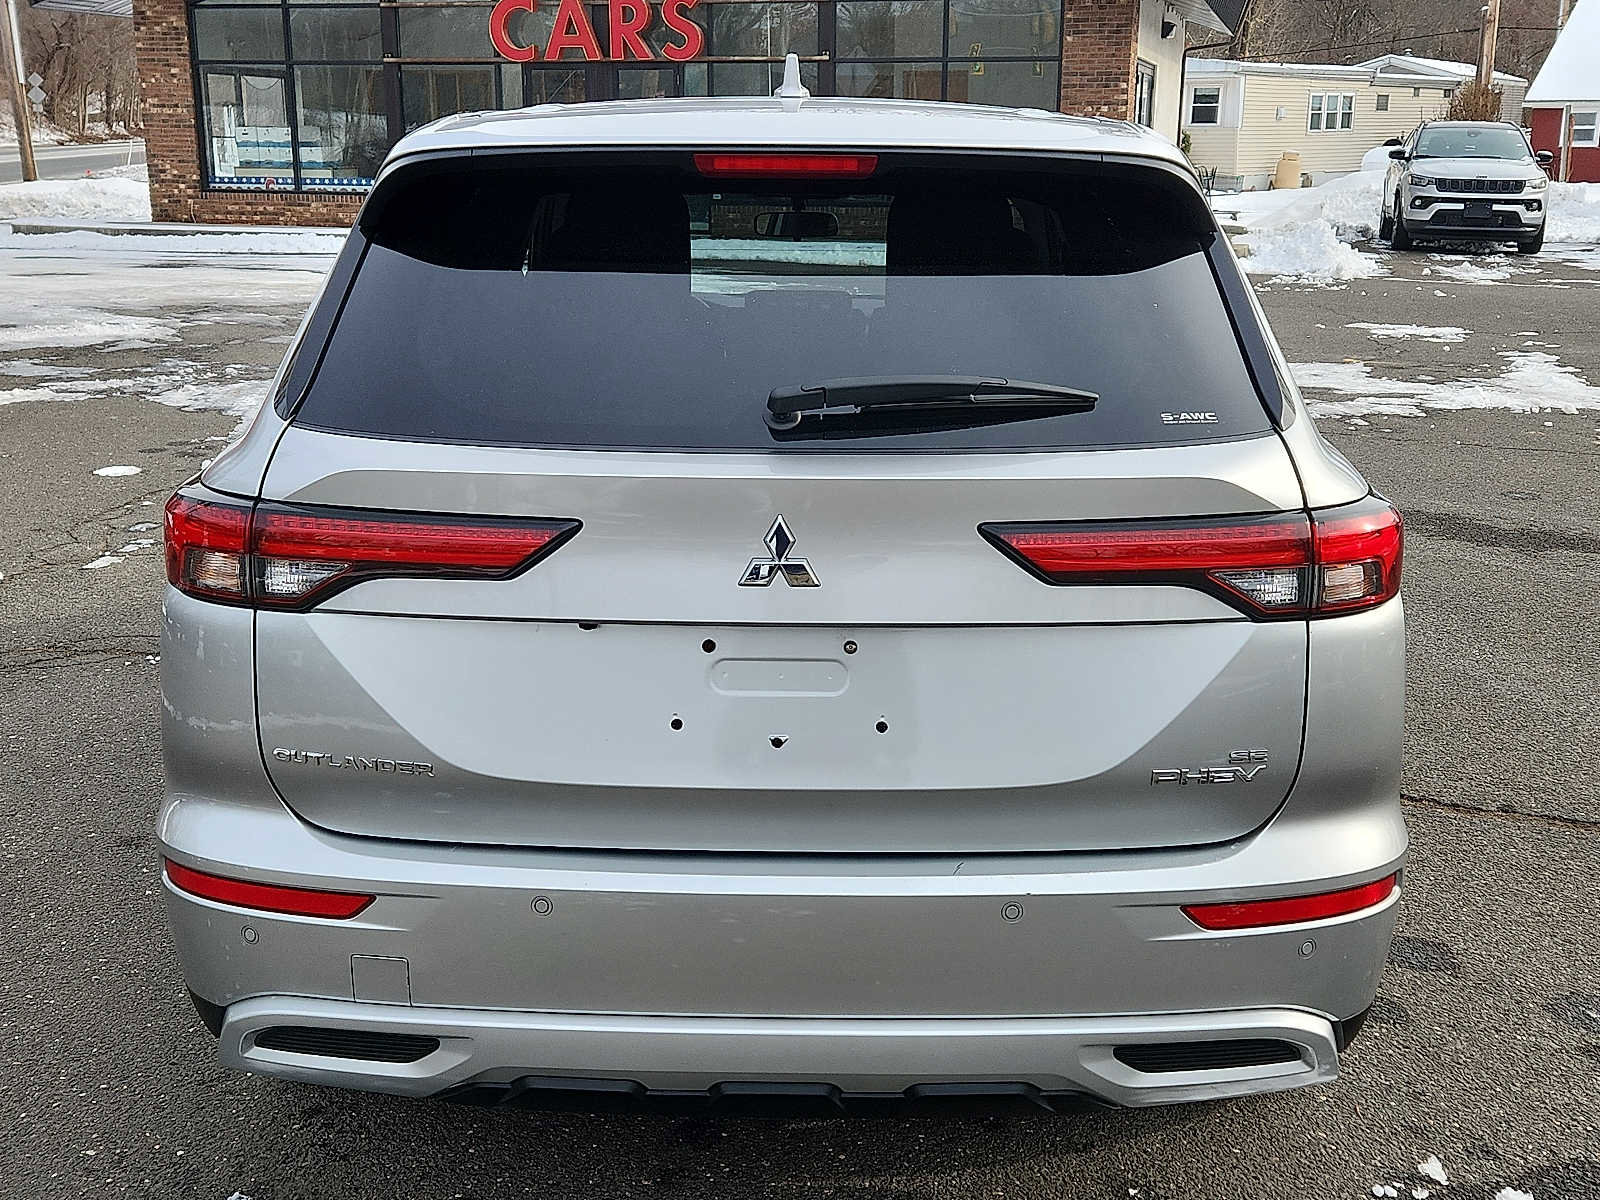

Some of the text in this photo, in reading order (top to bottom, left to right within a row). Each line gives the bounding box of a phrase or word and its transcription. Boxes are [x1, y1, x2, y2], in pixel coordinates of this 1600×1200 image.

[489, 0, 704, 62] CARS
[1160, 411, 1218, 421] S-AWC
[272, 747, 435, 778] OUTLANDER
[1150, 764, 1267, 785] PHEV
